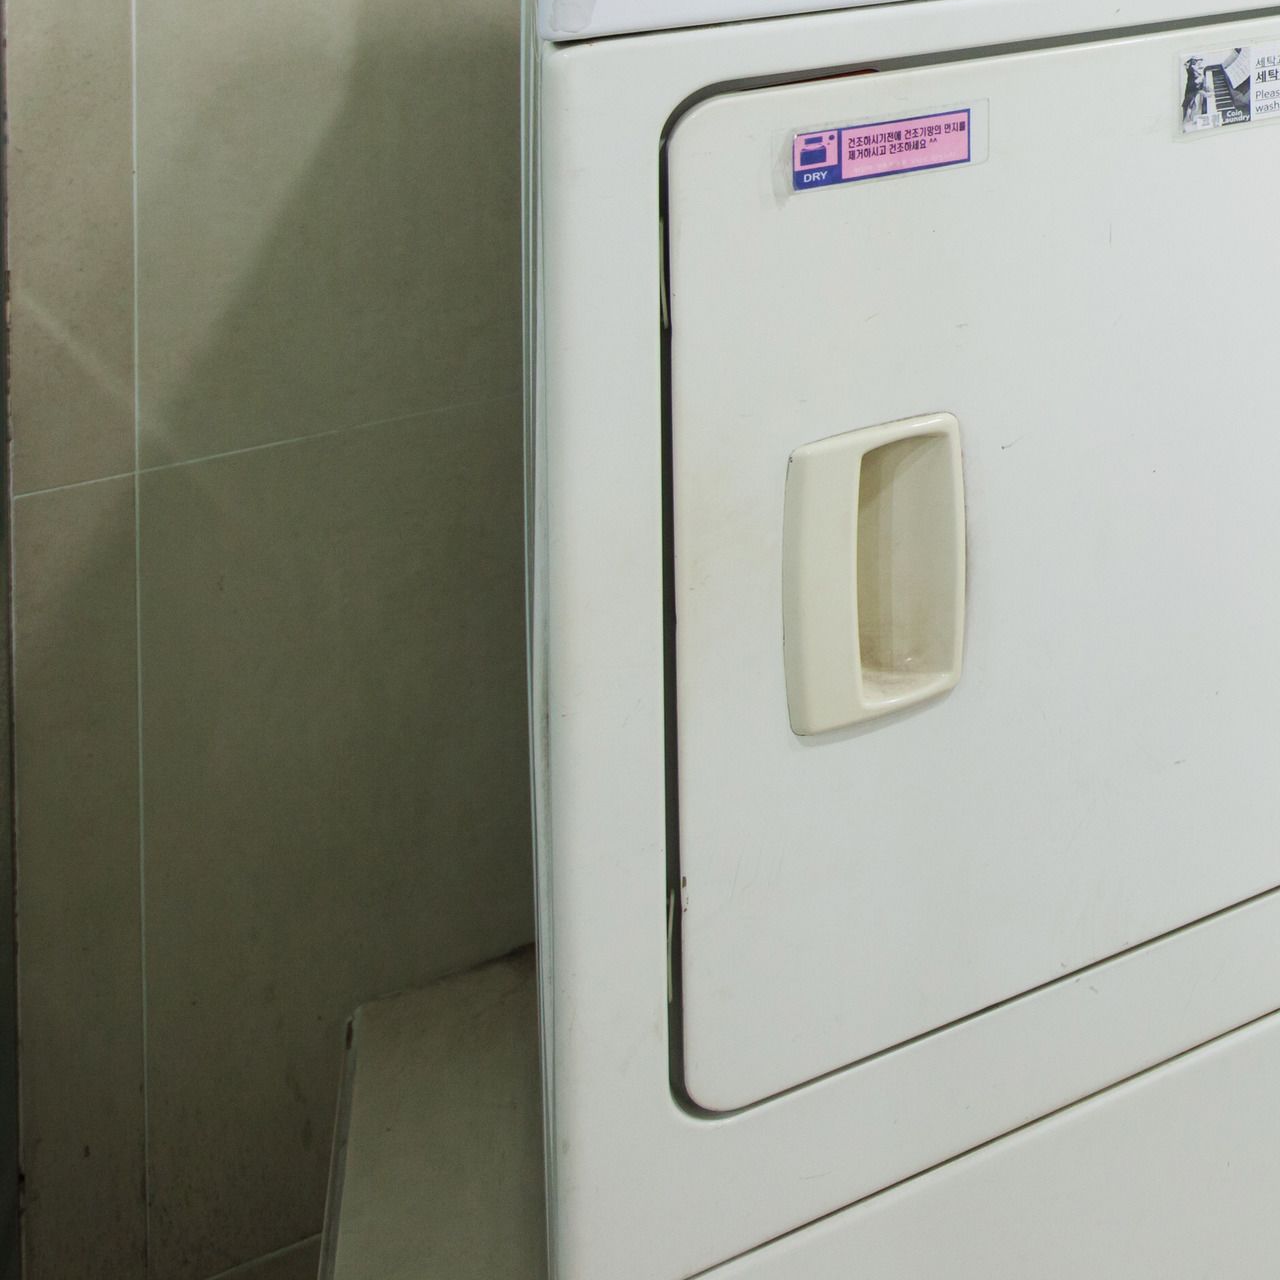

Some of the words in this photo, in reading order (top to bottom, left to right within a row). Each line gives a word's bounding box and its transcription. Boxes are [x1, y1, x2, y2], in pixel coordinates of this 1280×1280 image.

[848, 131, 902, 149] 건조하시기전에
[904, 126, 942, 142] 건조기망의
[848, 146, 887, 162] 제거하시고
[889, 140, 927, 156] 건조하세요
[803, 171, 829, 183] DRY
